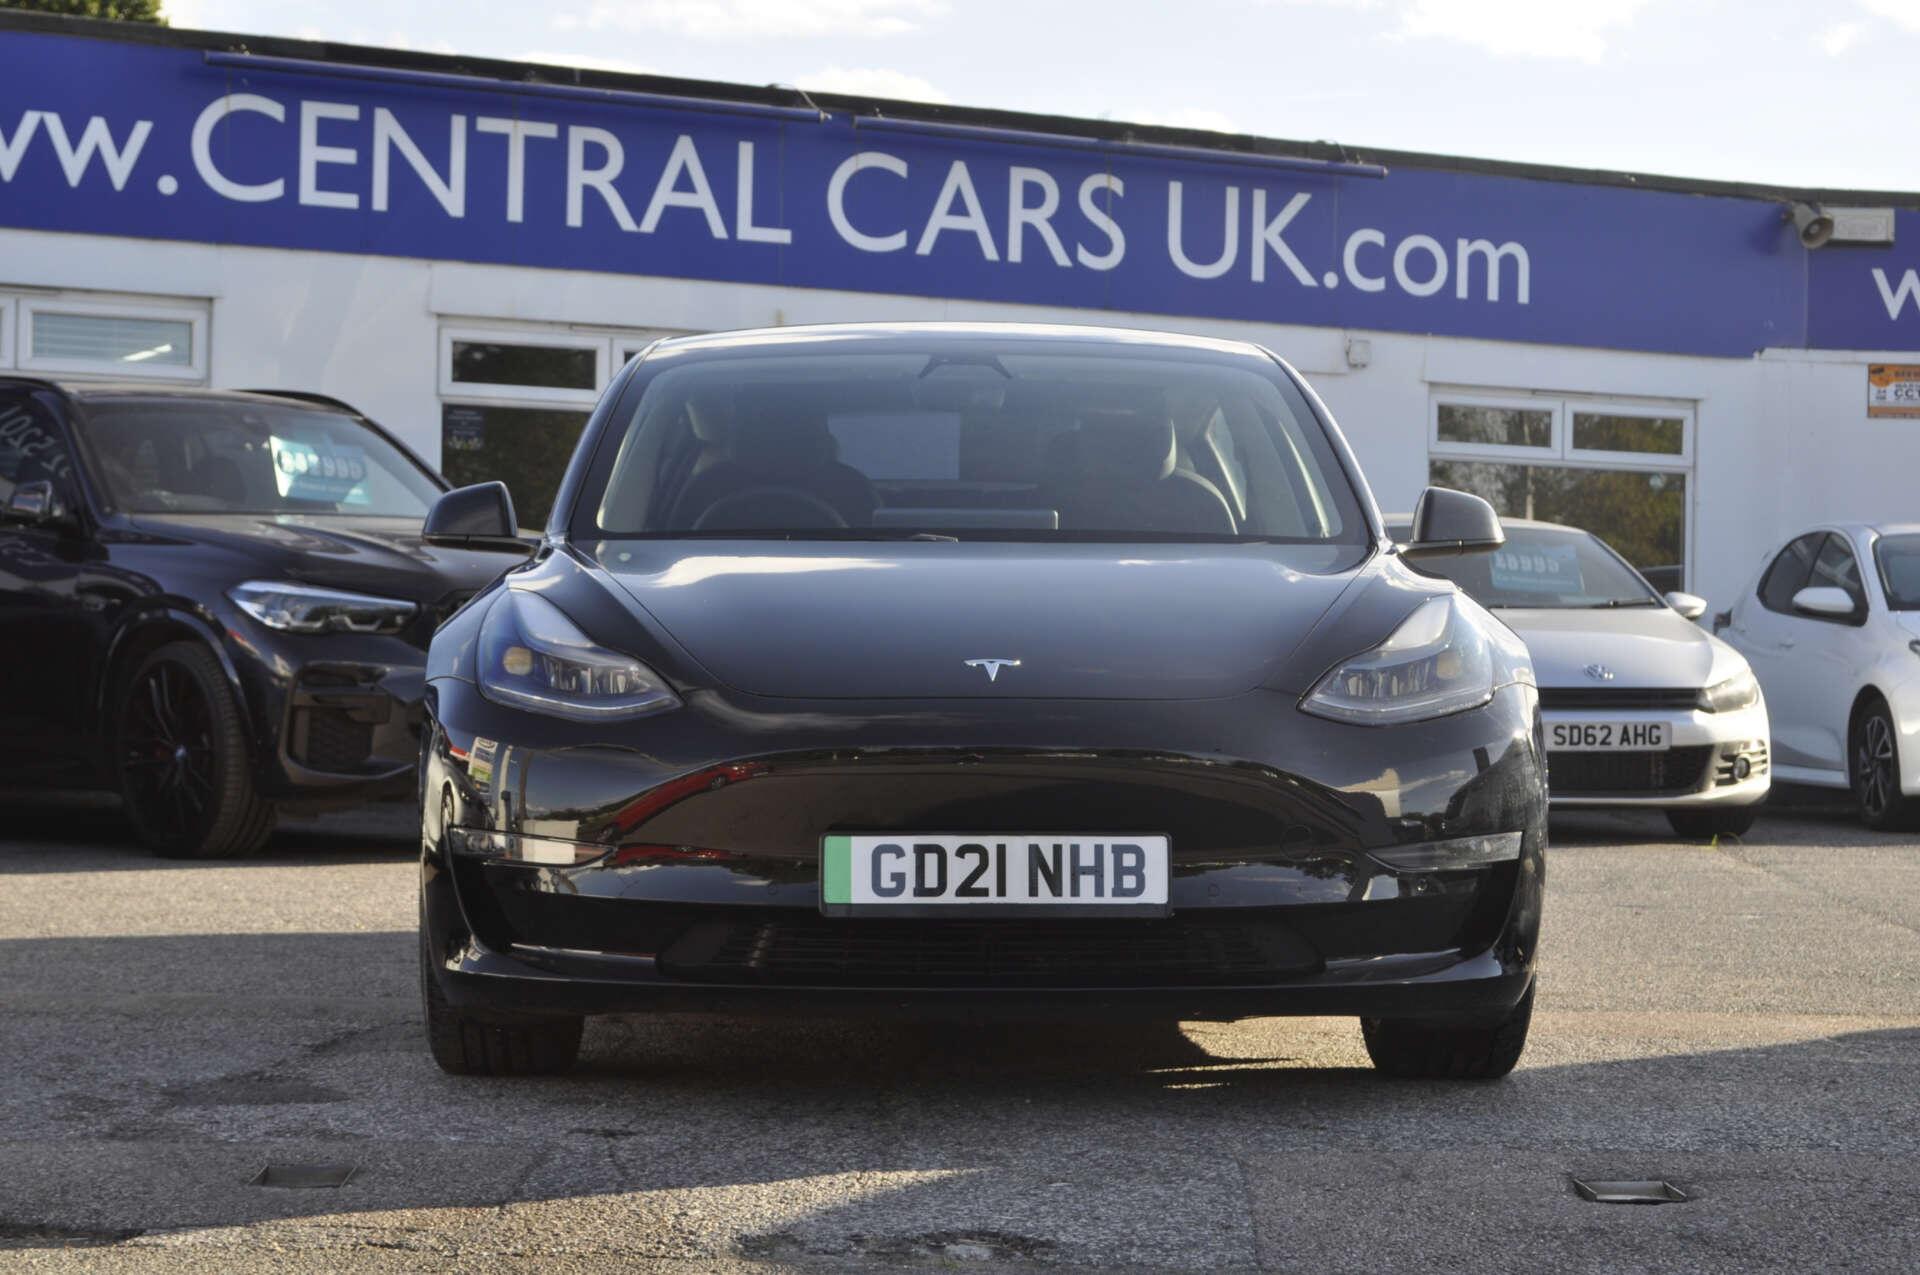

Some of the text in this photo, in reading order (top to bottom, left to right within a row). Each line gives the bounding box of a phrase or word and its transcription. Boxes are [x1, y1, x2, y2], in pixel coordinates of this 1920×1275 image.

[827, 152, 1126, 271] CARS
[1167, 181, 1530, 305] UK.com
[1553, 724, 1662, 746] SD62 AHG
[871, 843, 1146, 898] GD21 NHB
